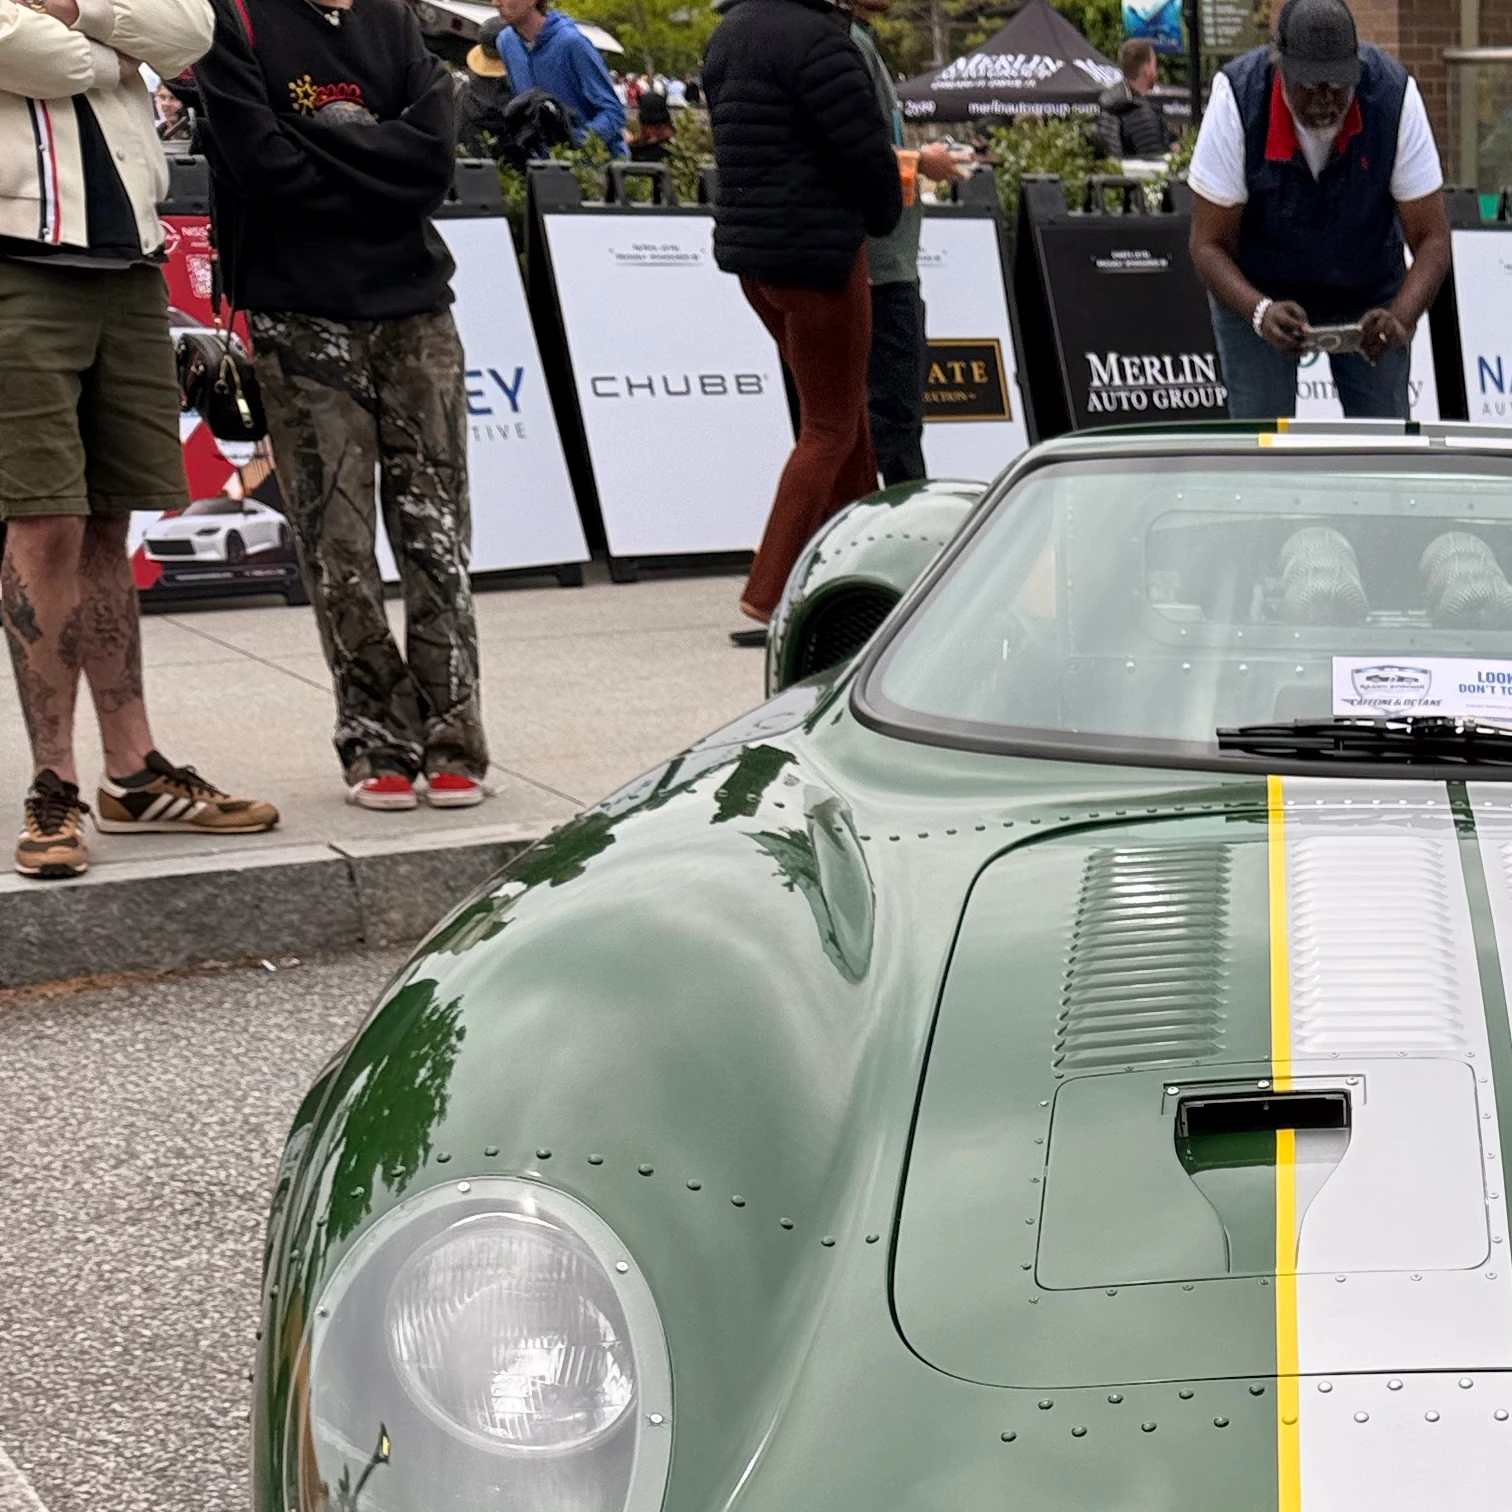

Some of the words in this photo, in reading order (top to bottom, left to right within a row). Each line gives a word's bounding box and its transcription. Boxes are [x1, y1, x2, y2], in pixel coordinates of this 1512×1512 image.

[1084, 351, 1217, 387] MERLIN
[1087, 390, 1148, 412] AUTO
[1152, 386, 1228, 410] GROUP
[1458, 683, 1496, 695] DON'T
